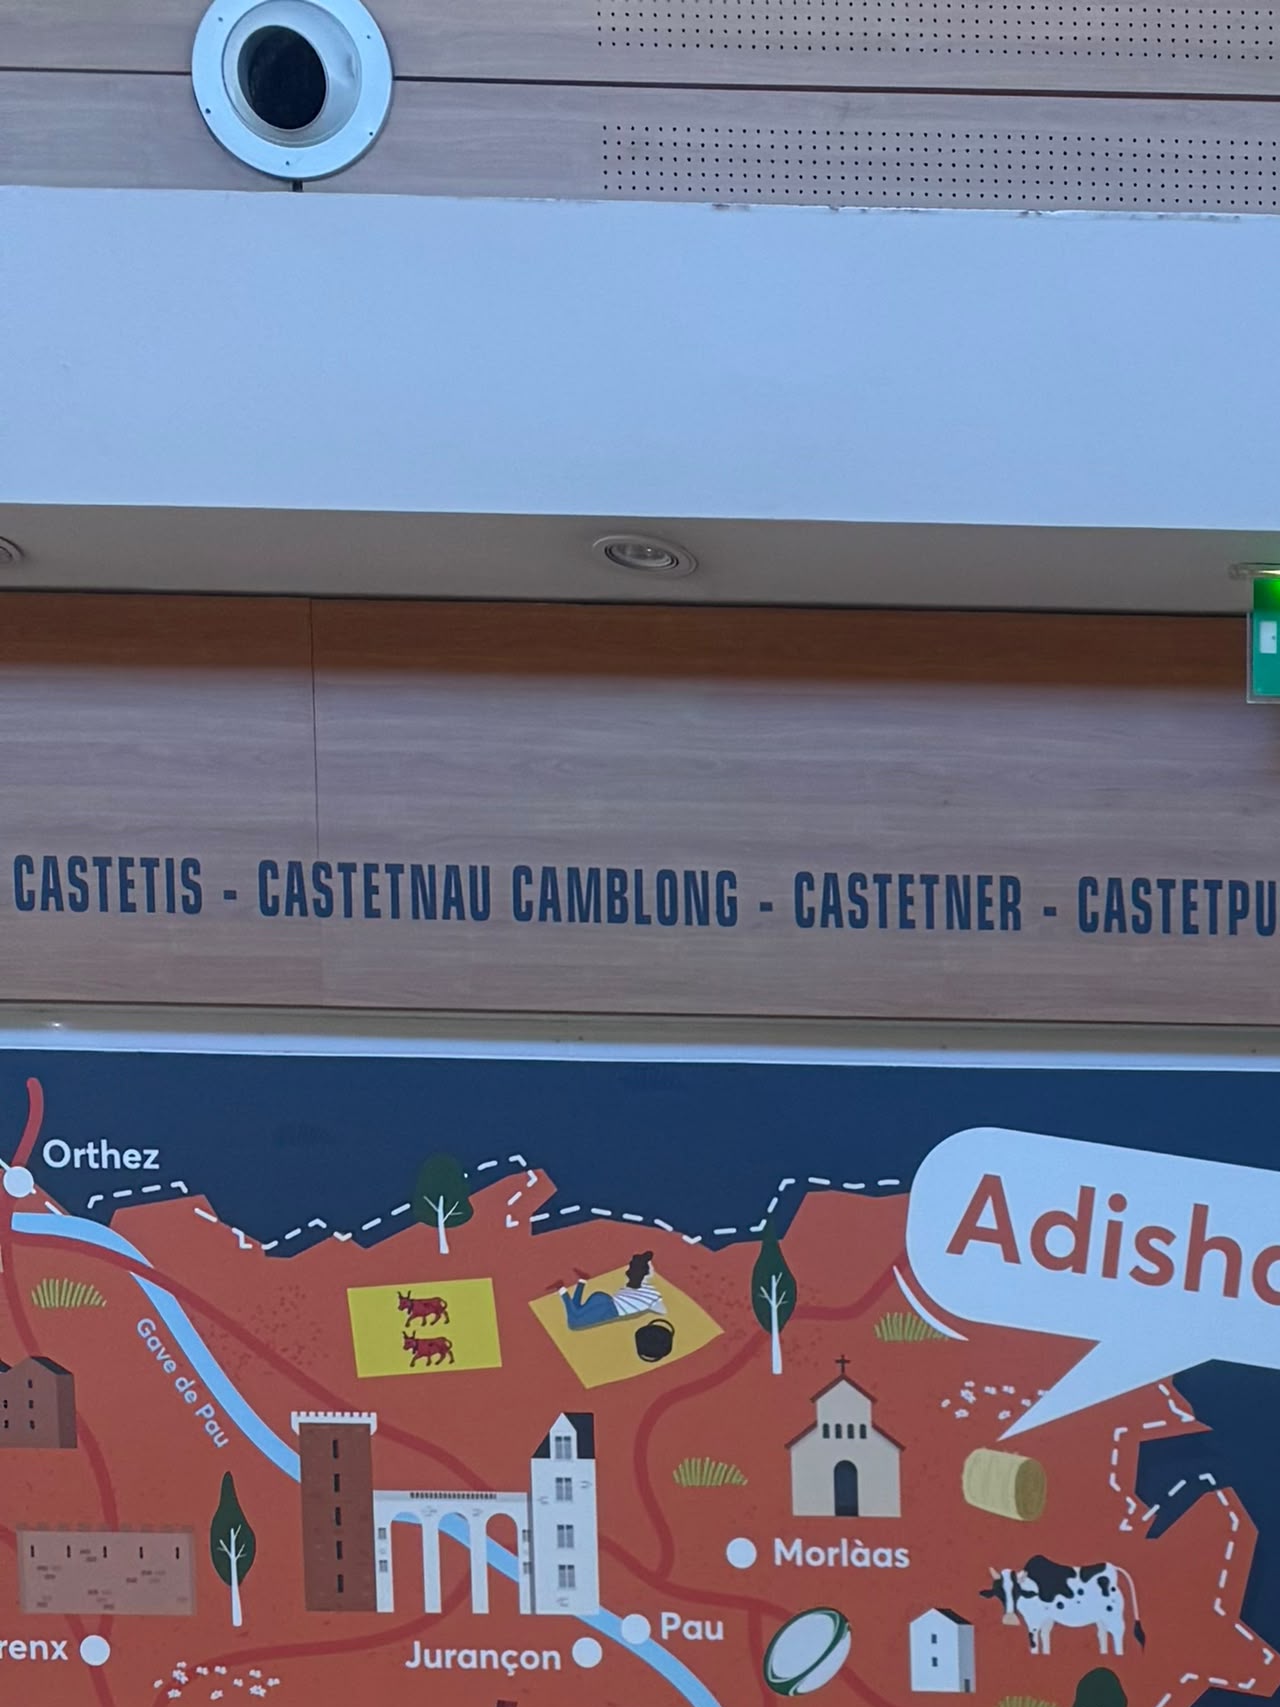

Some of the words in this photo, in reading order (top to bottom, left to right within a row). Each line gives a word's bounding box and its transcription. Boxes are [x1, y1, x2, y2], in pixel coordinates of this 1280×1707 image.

[13, 854, 202, 914] CASTETIS
[258, 859, 490, 921] CASTETNAU
[511, 865, 738, 927] CAMBLONG
[793, 871, 1021, 931] CASTETNER
[42, 1138, 160, 1170] Orthez
[136, 1317, 177, 1374] Gave
[175, 1376, 198, 1404] de
[194, 1402, 230, 1449] Pau
[773, 1537, 911, 1569] Morlàas
[660, 1611, 725, 1641] Pau
[0, 1639, 69, 1661] renx
[404, 1640, 562, 1677] Jurançon
